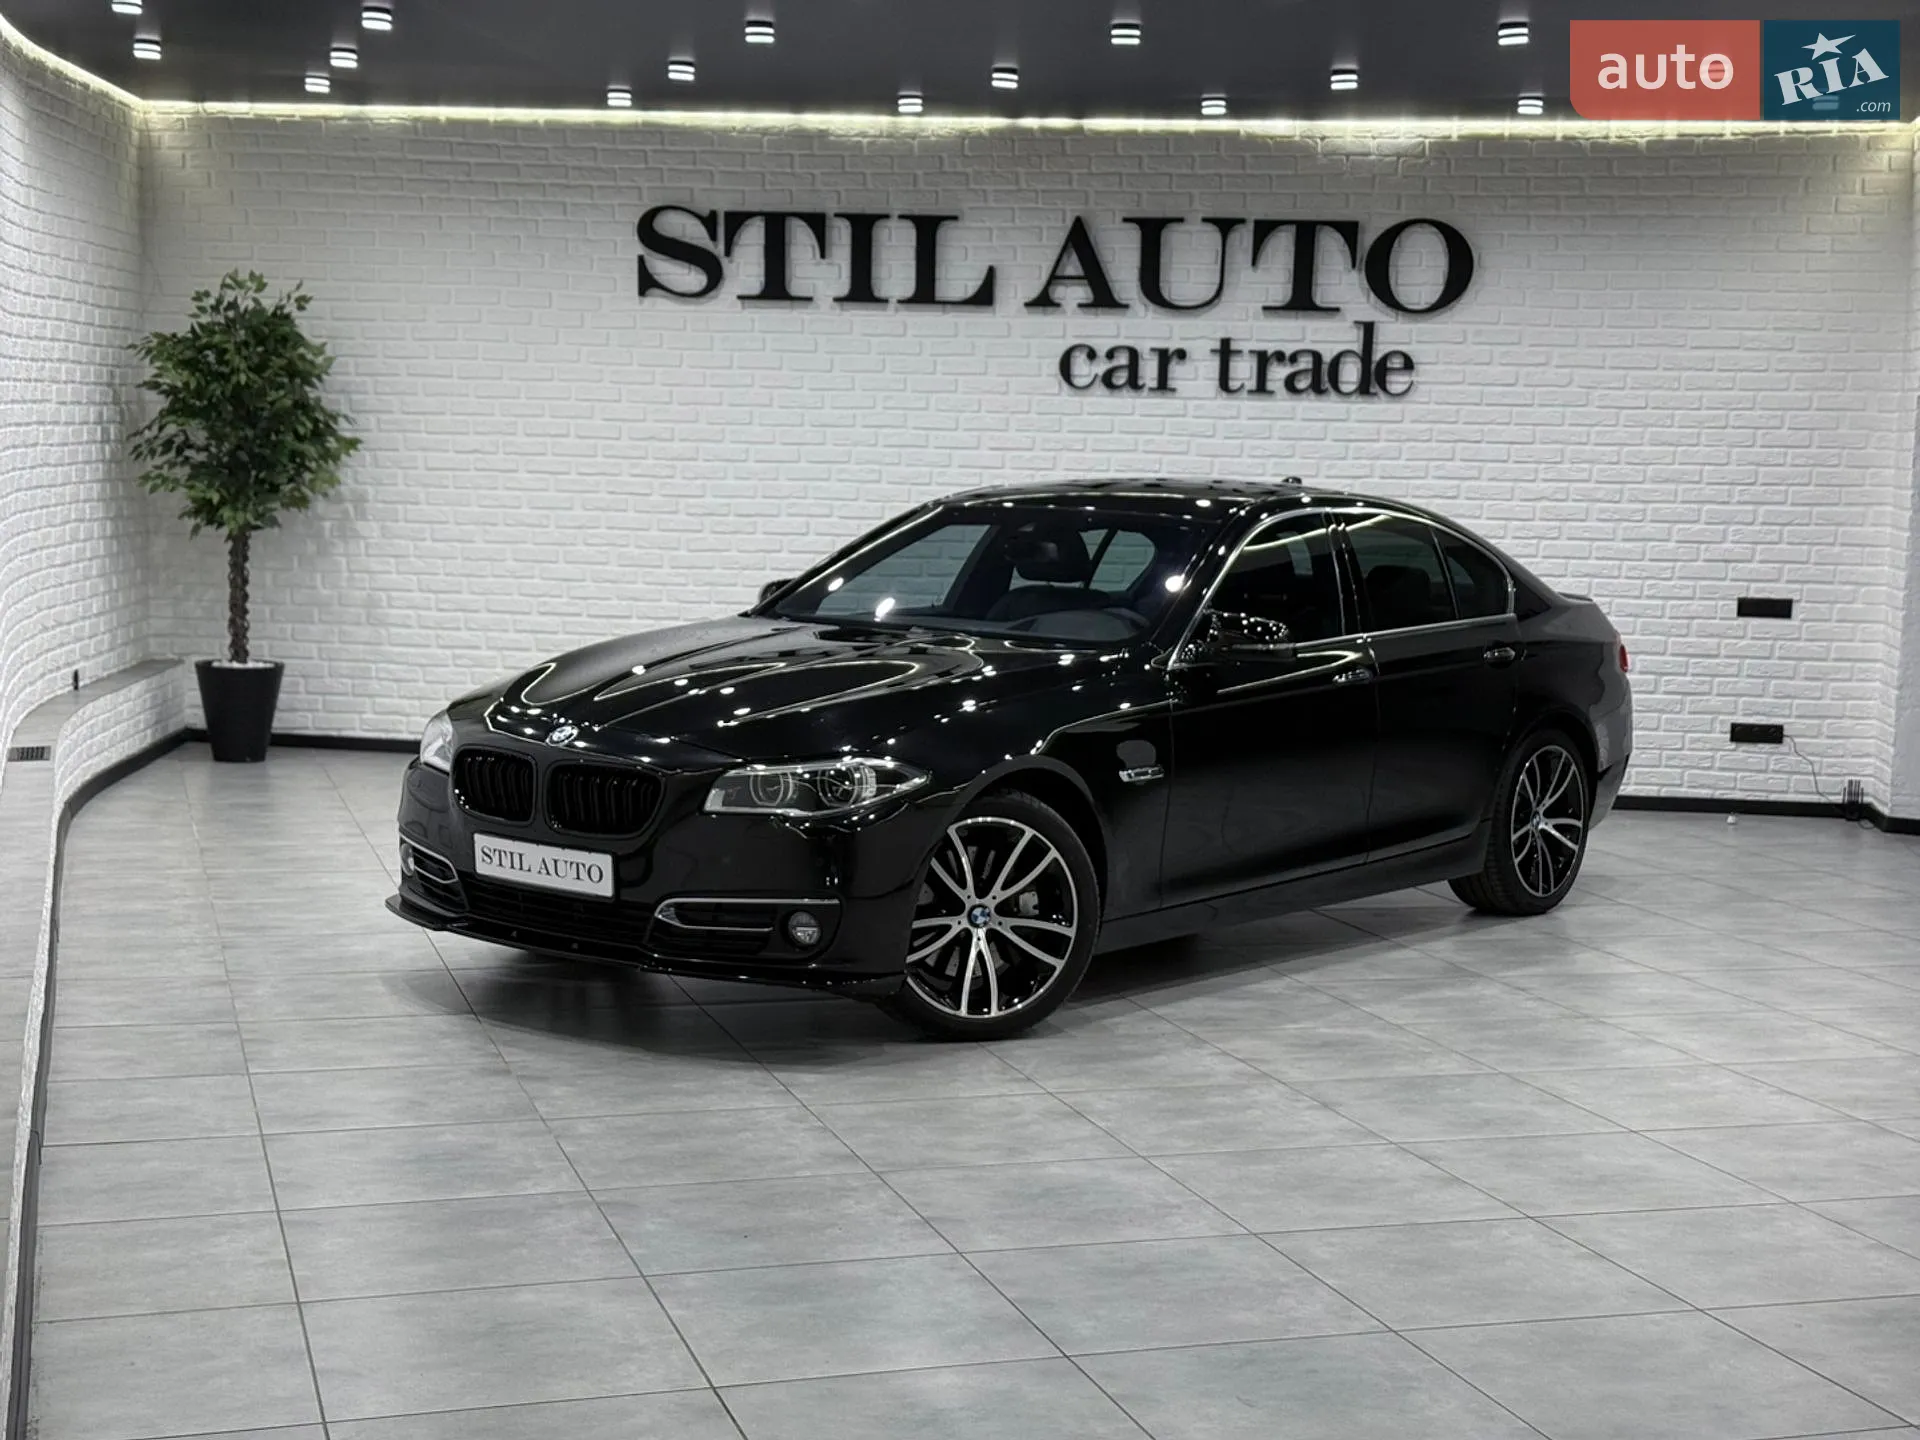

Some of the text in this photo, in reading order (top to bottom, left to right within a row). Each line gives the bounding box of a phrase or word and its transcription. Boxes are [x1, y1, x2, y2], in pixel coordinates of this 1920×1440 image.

[636, 205, 1476, 314] STIL AUTO
[1058, 321, 1416, 397] car trade
[480, 845, 604, 884] STIL AUTO
